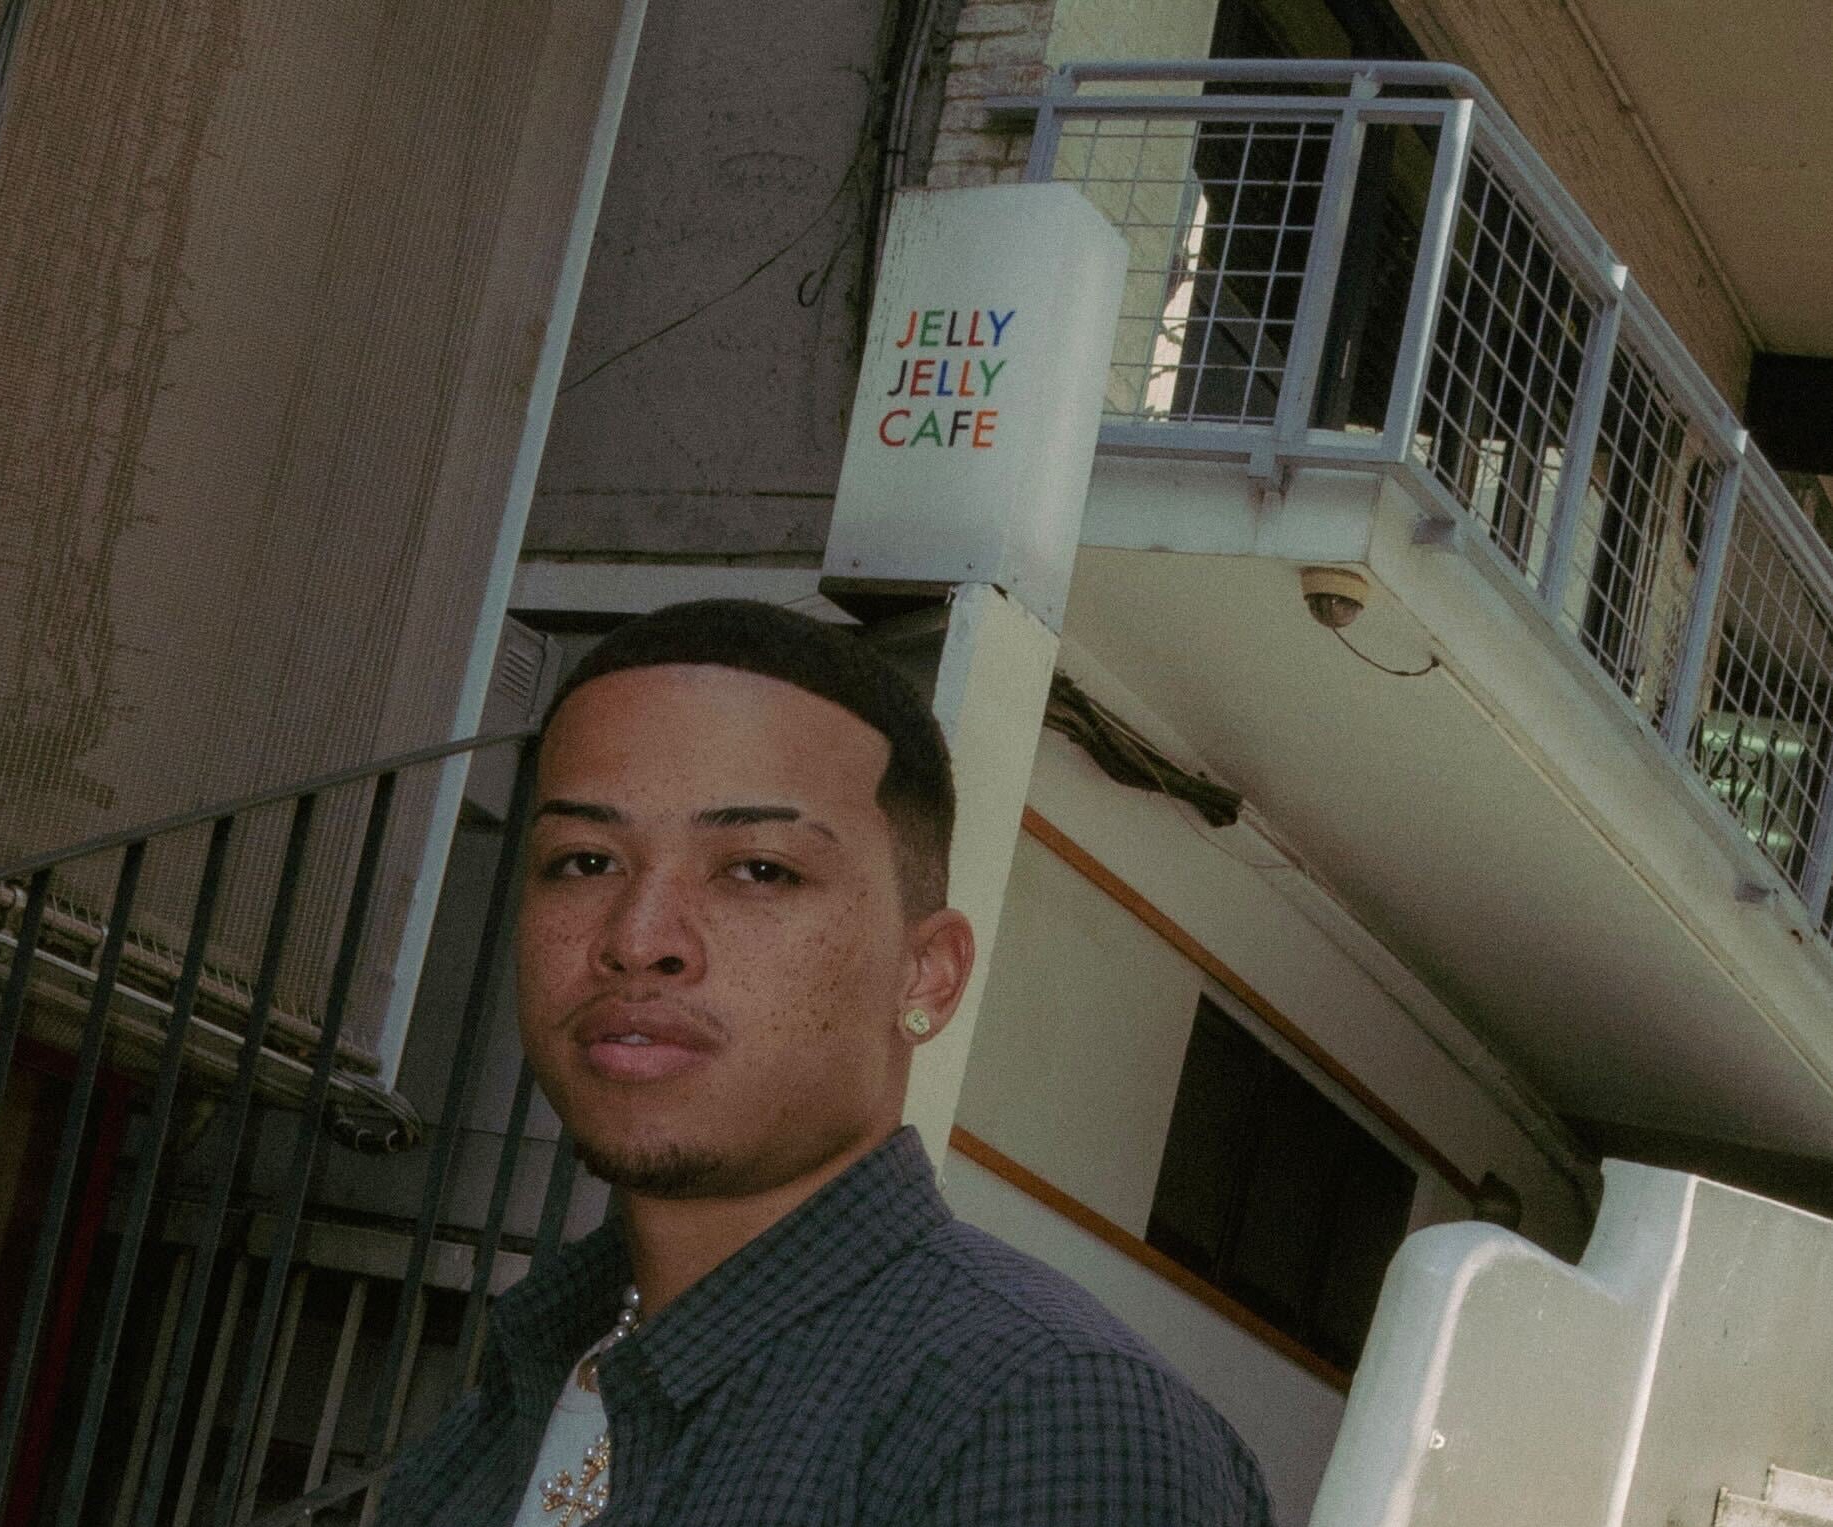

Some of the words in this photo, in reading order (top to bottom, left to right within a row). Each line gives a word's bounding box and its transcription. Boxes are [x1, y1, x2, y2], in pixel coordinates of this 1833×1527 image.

[896, 310, 1016, 349] JELLY
[887, 359, 1006, 397] JELLY
[879, 409, 999, 448] CAFE
